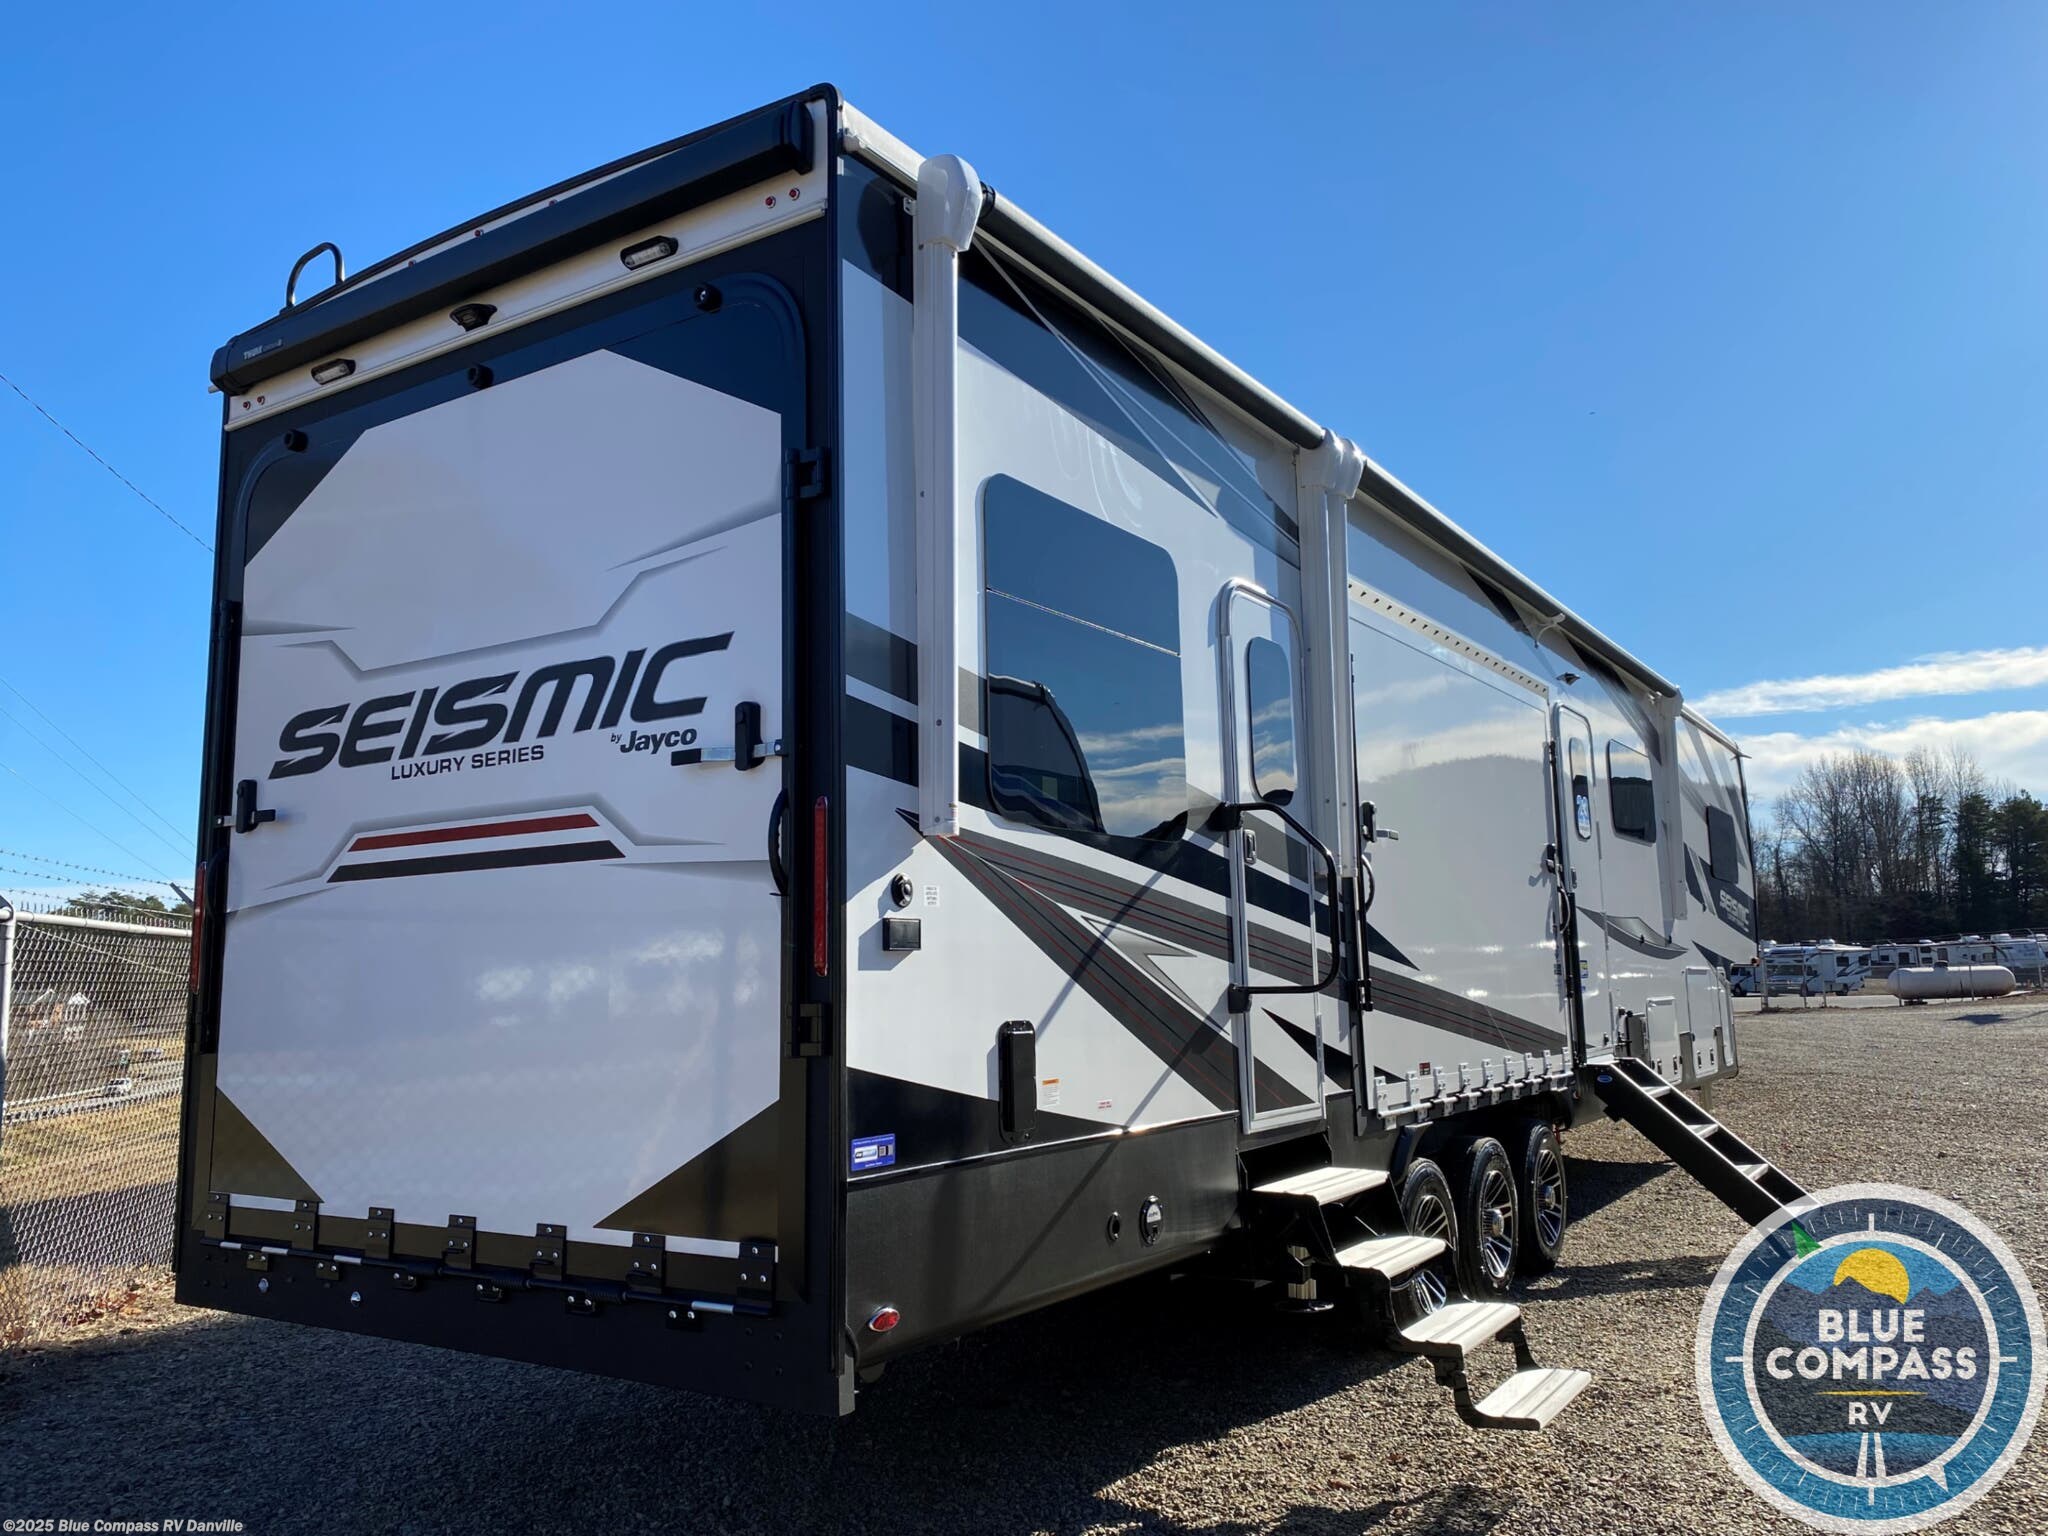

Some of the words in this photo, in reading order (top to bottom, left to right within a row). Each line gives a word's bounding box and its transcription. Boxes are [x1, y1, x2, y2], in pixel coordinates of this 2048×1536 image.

[268, 631, 734, 779] SEISMIC
[610, 733, 622, 744] by
[620, 728, 698, 754] Jayco
[391, 757, 466, 780] LUXURY
[471, 745, 544, 769] SERIES
